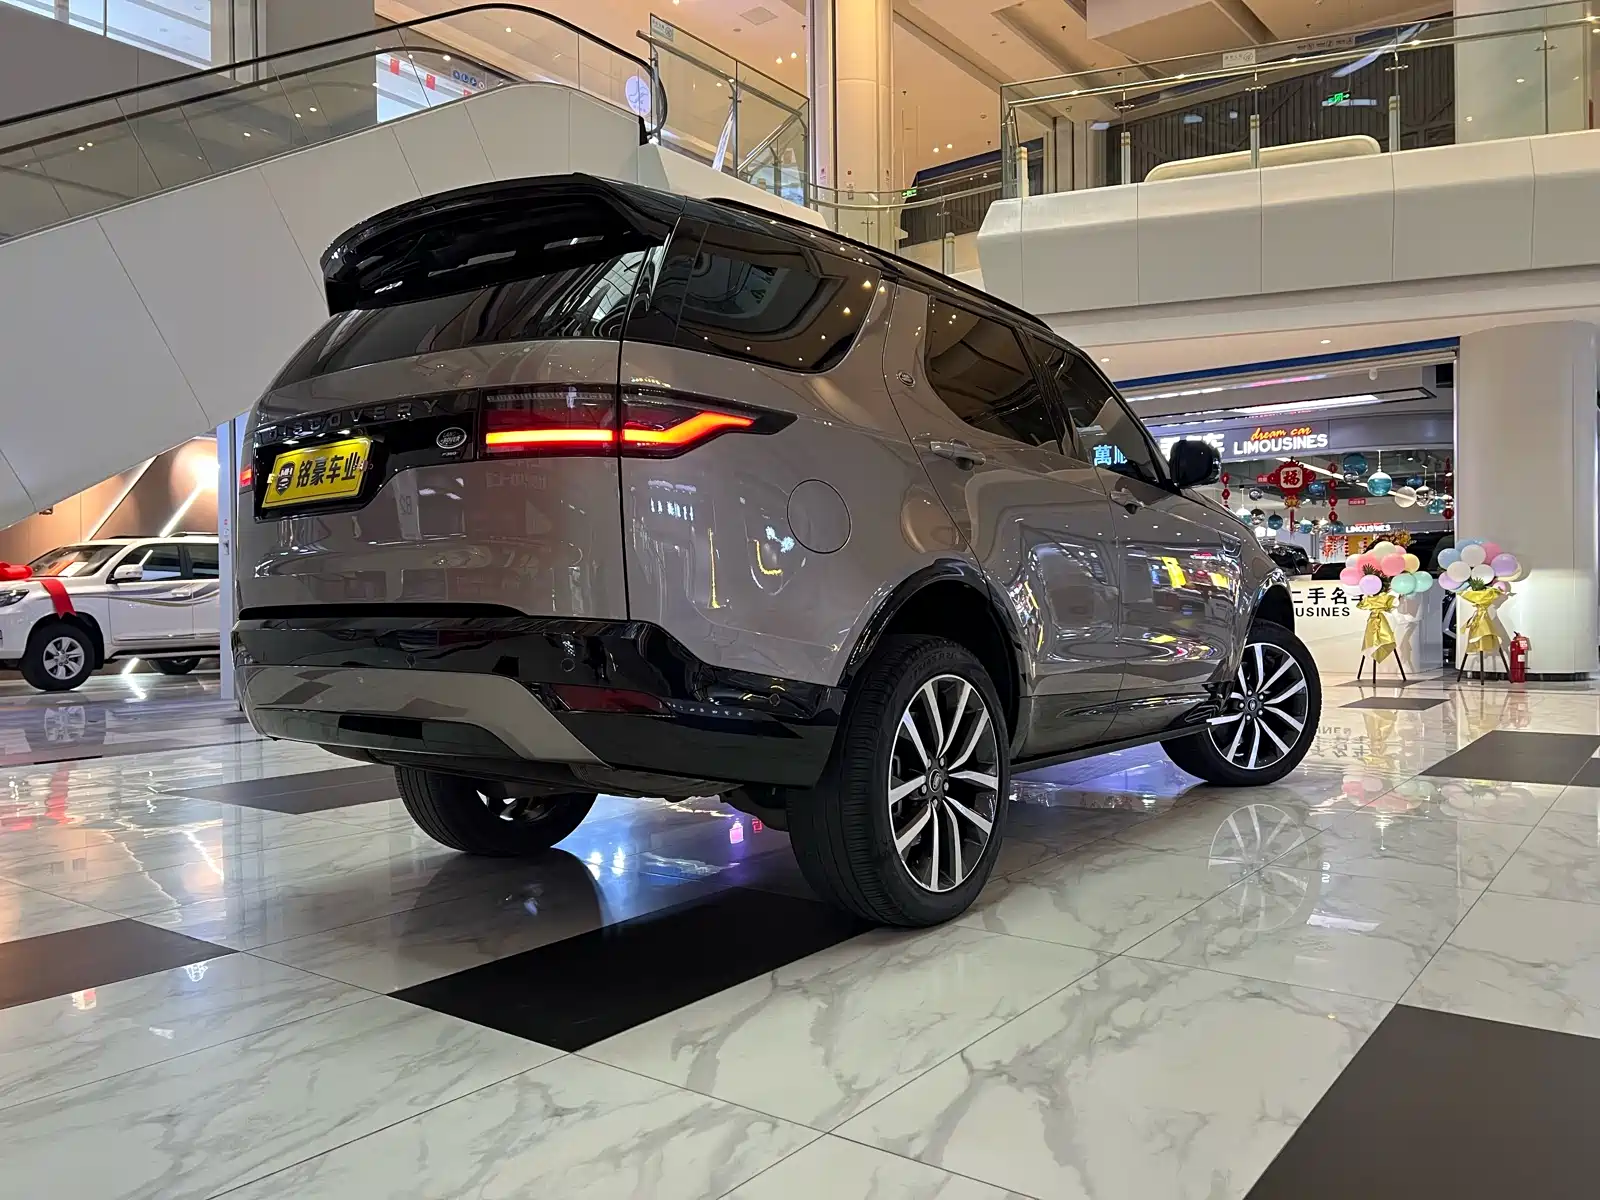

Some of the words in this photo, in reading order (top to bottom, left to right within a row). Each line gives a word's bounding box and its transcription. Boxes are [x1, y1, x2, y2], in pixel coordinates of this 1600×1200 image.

[1250, 427, 1287, 441] dream
[1290, 425, 1312, 436] car
[1233, 433, 1328, 455] LIMOUSINES
[296, 452, 361, 488] 铭豪车业
[1283, 469, 1300, 486] 福
[1295, 607, 1350, 617] USINES
